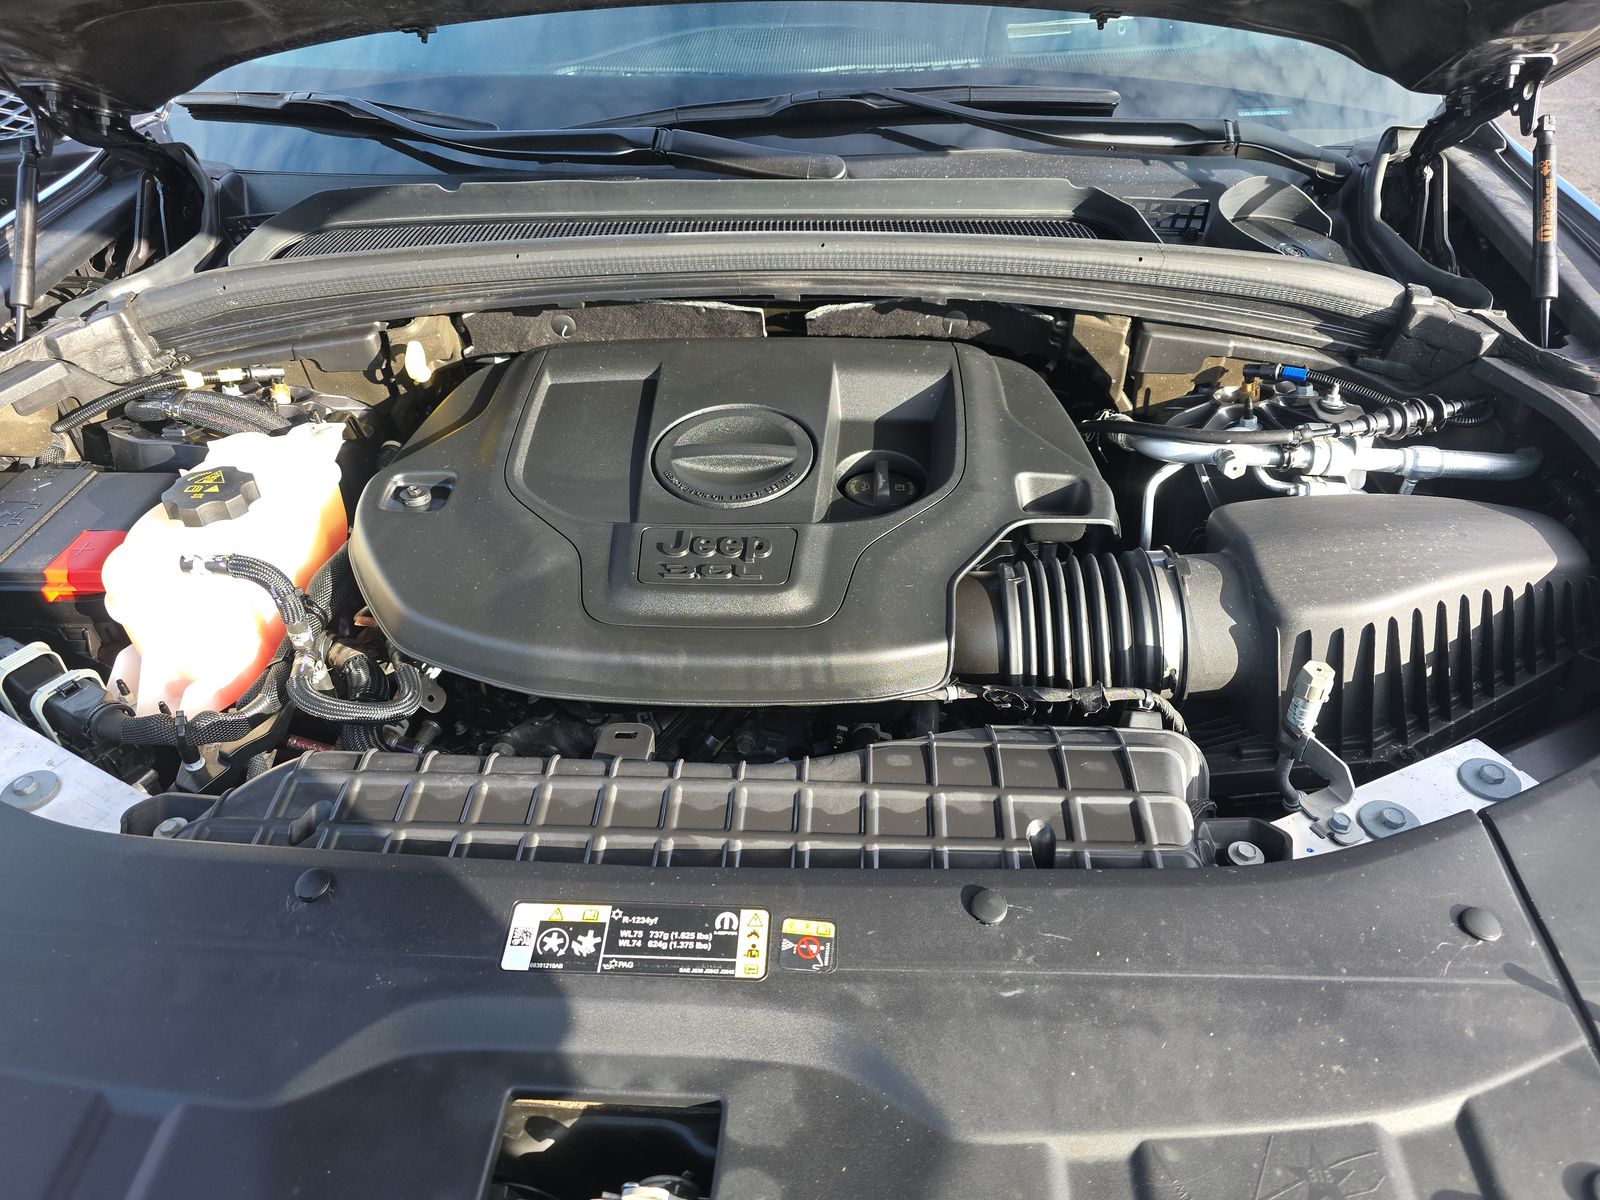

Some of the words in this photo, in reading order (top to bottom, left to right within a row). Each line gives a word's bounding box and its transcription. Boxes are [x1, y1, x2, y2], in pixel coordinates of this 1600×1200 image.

[690, 488, 709, 499] FOR
[656, 529, 773, 563] Jeep
[621, 916, 659, 926] R-1234yf
[619, 929, 644, 938] WL75
[649, 930, 669, 940] 737g
[696, 931, 713, 942] lbs)
[618, 939, 642, 948] WL74
[647, 939, 668, 950] 624g
[669, 940, 695, 951] (1.375
[695, 941, 712, 952] lbs)
[618, 961, 634, 969] PAG
